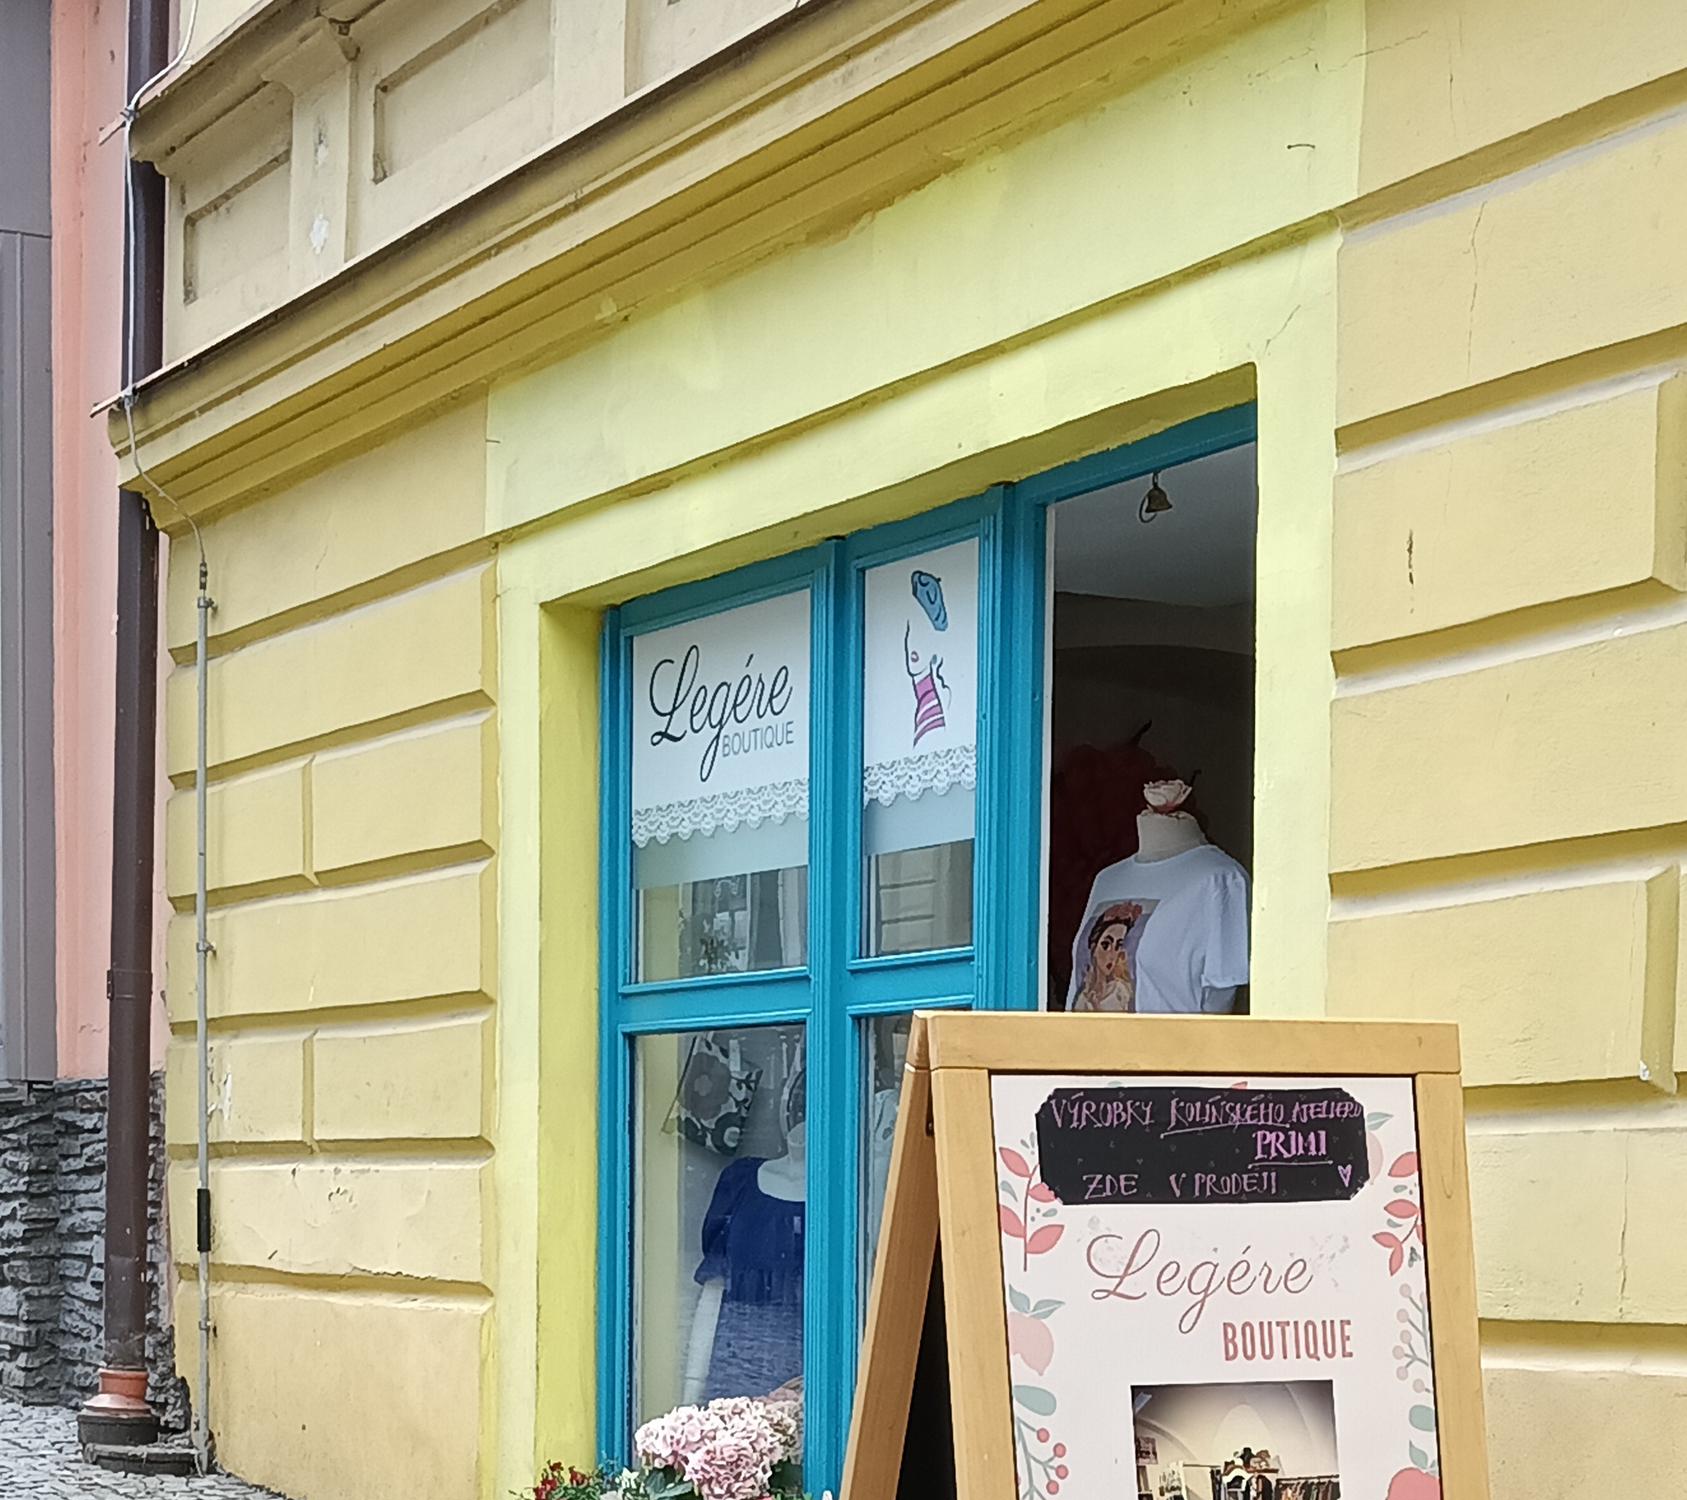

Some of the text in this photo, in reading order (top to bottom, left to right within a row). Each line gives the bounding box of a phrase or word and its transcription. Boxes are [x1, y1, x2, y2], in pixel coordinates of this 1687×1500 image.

[650, 645, 793, 782] Legére
[721, 721, 794, 757] BOUTIQUE
[1050, 1092, 1155, 1130] VÝROBKY
[1166, 1094, 1285, 1133] KOLÍNSKÉHO
[1252, 1130, 1326, 1160] PRIMI
[1083, 1172, 1277, 1199] ZDE V PRODEJI
[1086, 1228, 1314, 1334] Legére
[1223, 1319, 1353, 1362] BOUTIQUE
